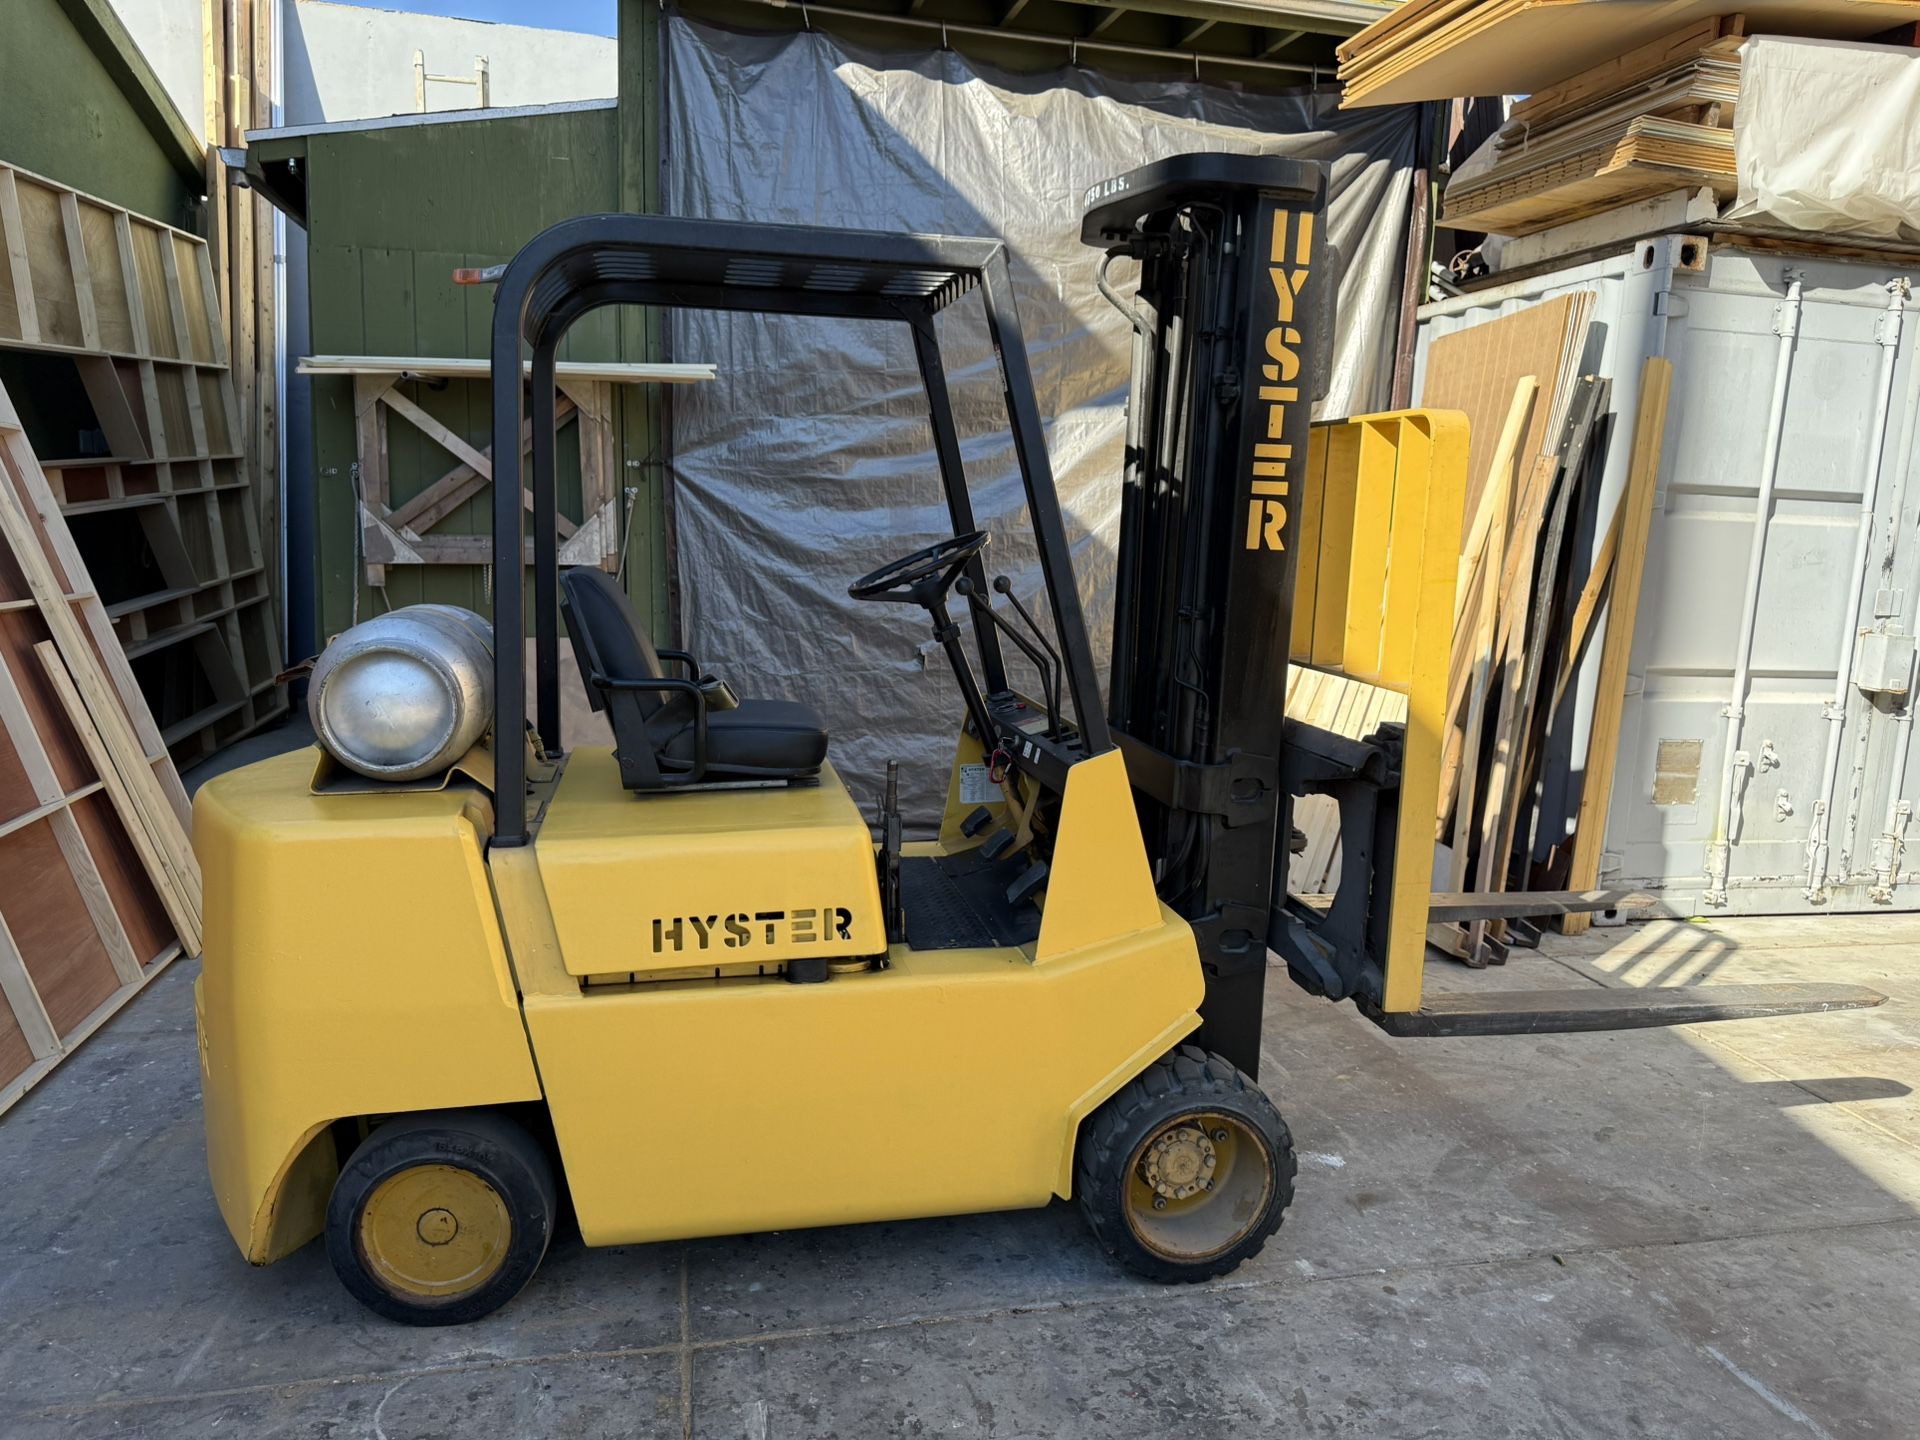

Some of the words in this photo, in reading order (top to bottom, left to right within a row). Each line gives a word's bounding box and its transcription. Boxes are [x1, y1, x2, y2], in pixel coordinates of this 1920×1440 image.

[1104, 176, 1130, 196] LBS.
[1246, 209, 1314, 551] HYSTER
[652, 907, 853, 952] HYSTER
